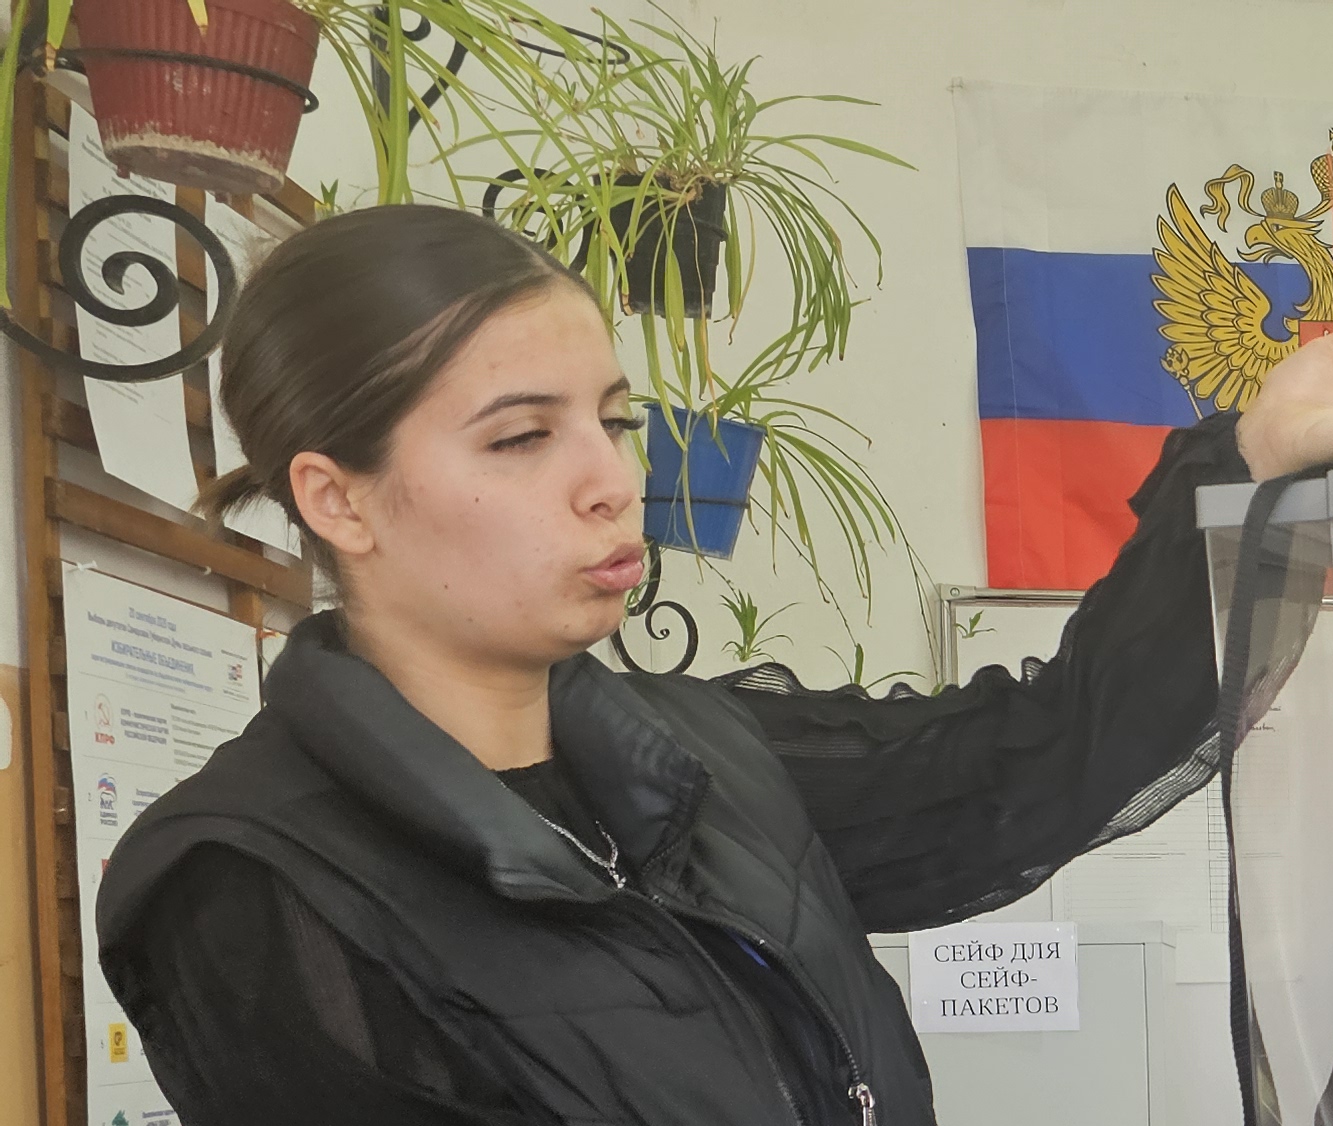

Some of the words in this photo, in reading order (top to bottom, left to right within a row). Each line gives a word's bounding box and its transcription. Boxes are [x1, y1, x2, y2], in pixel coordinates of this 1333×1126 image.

[933, 940, 1004, 963] СЕЙФ
[1010, 941, 1062, 964] ДЛЯ
[959, 966, 1038, 989] СЕЙФ-
[940, 995, 1059, 1018] ПАКЕТОВ
